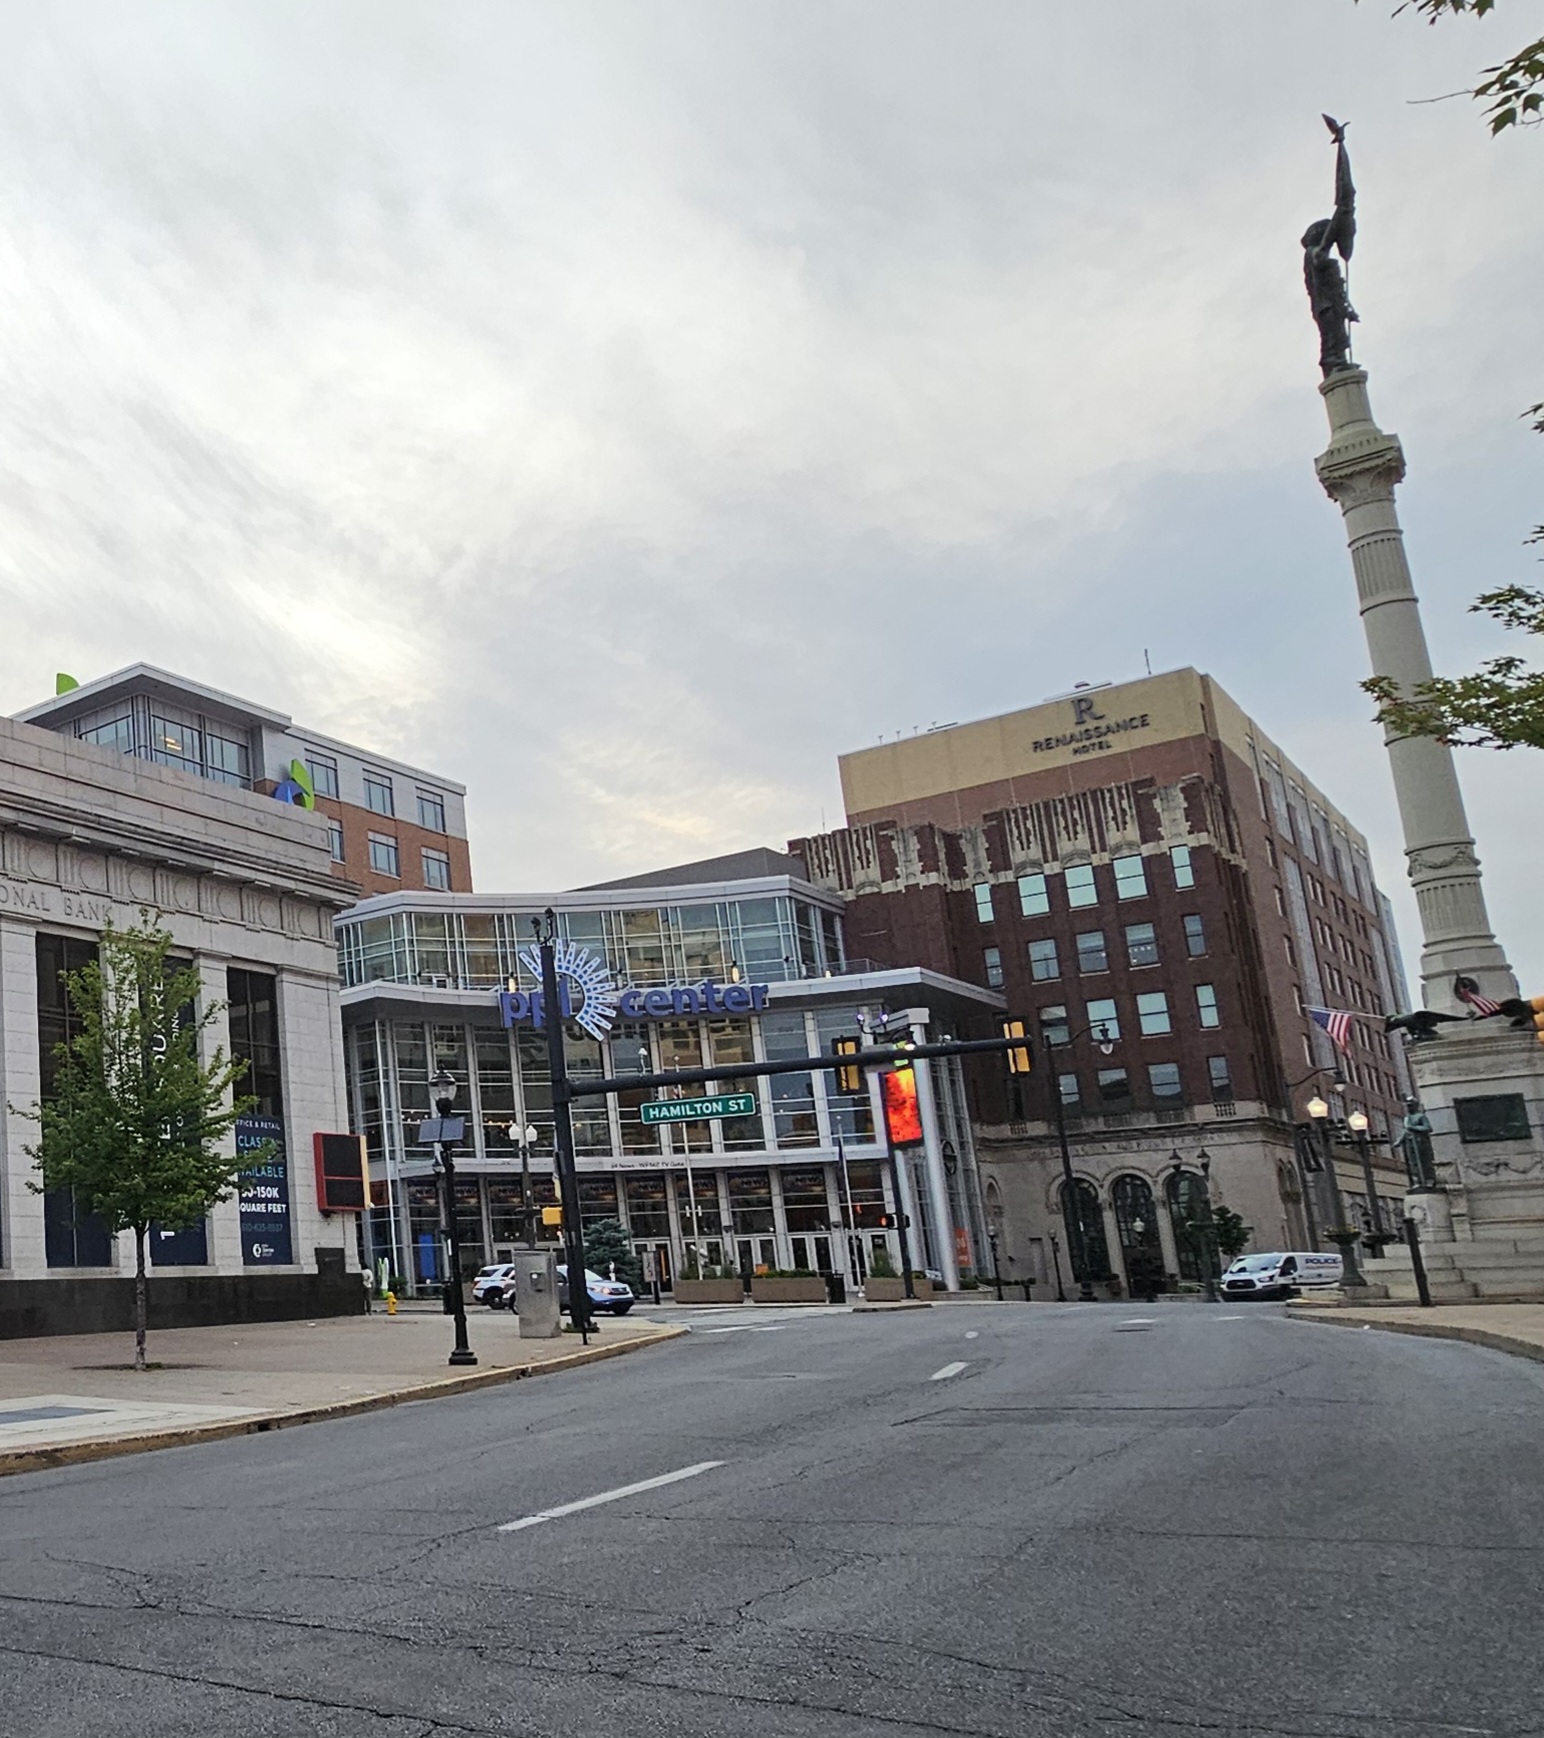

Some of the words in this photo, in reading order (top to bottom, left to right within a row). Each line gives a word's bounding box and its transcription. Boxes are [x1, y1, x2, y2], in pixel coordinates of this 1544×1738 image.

[1071, 697, 1106, 725] R
[1032, 713, 1150, 753] RENAISSANCE
[1072, 740, 1113, 755] HOTEL
[64, 896, 113, 923] BANK
[619, 980, 770, 1018] center
[649, 1101, 722, 1119] HAMILTON
[728, 1099, 746, 1112] ST
[236, 1119, 254, 1129] FFICE
[261, 1121, 281, 1131] RETAIL
[238, 1166, 284, 1179] AILABLE
[239, 1202, 267, 1213] QUARE
[268, 1203, 287, 1214] FEET
